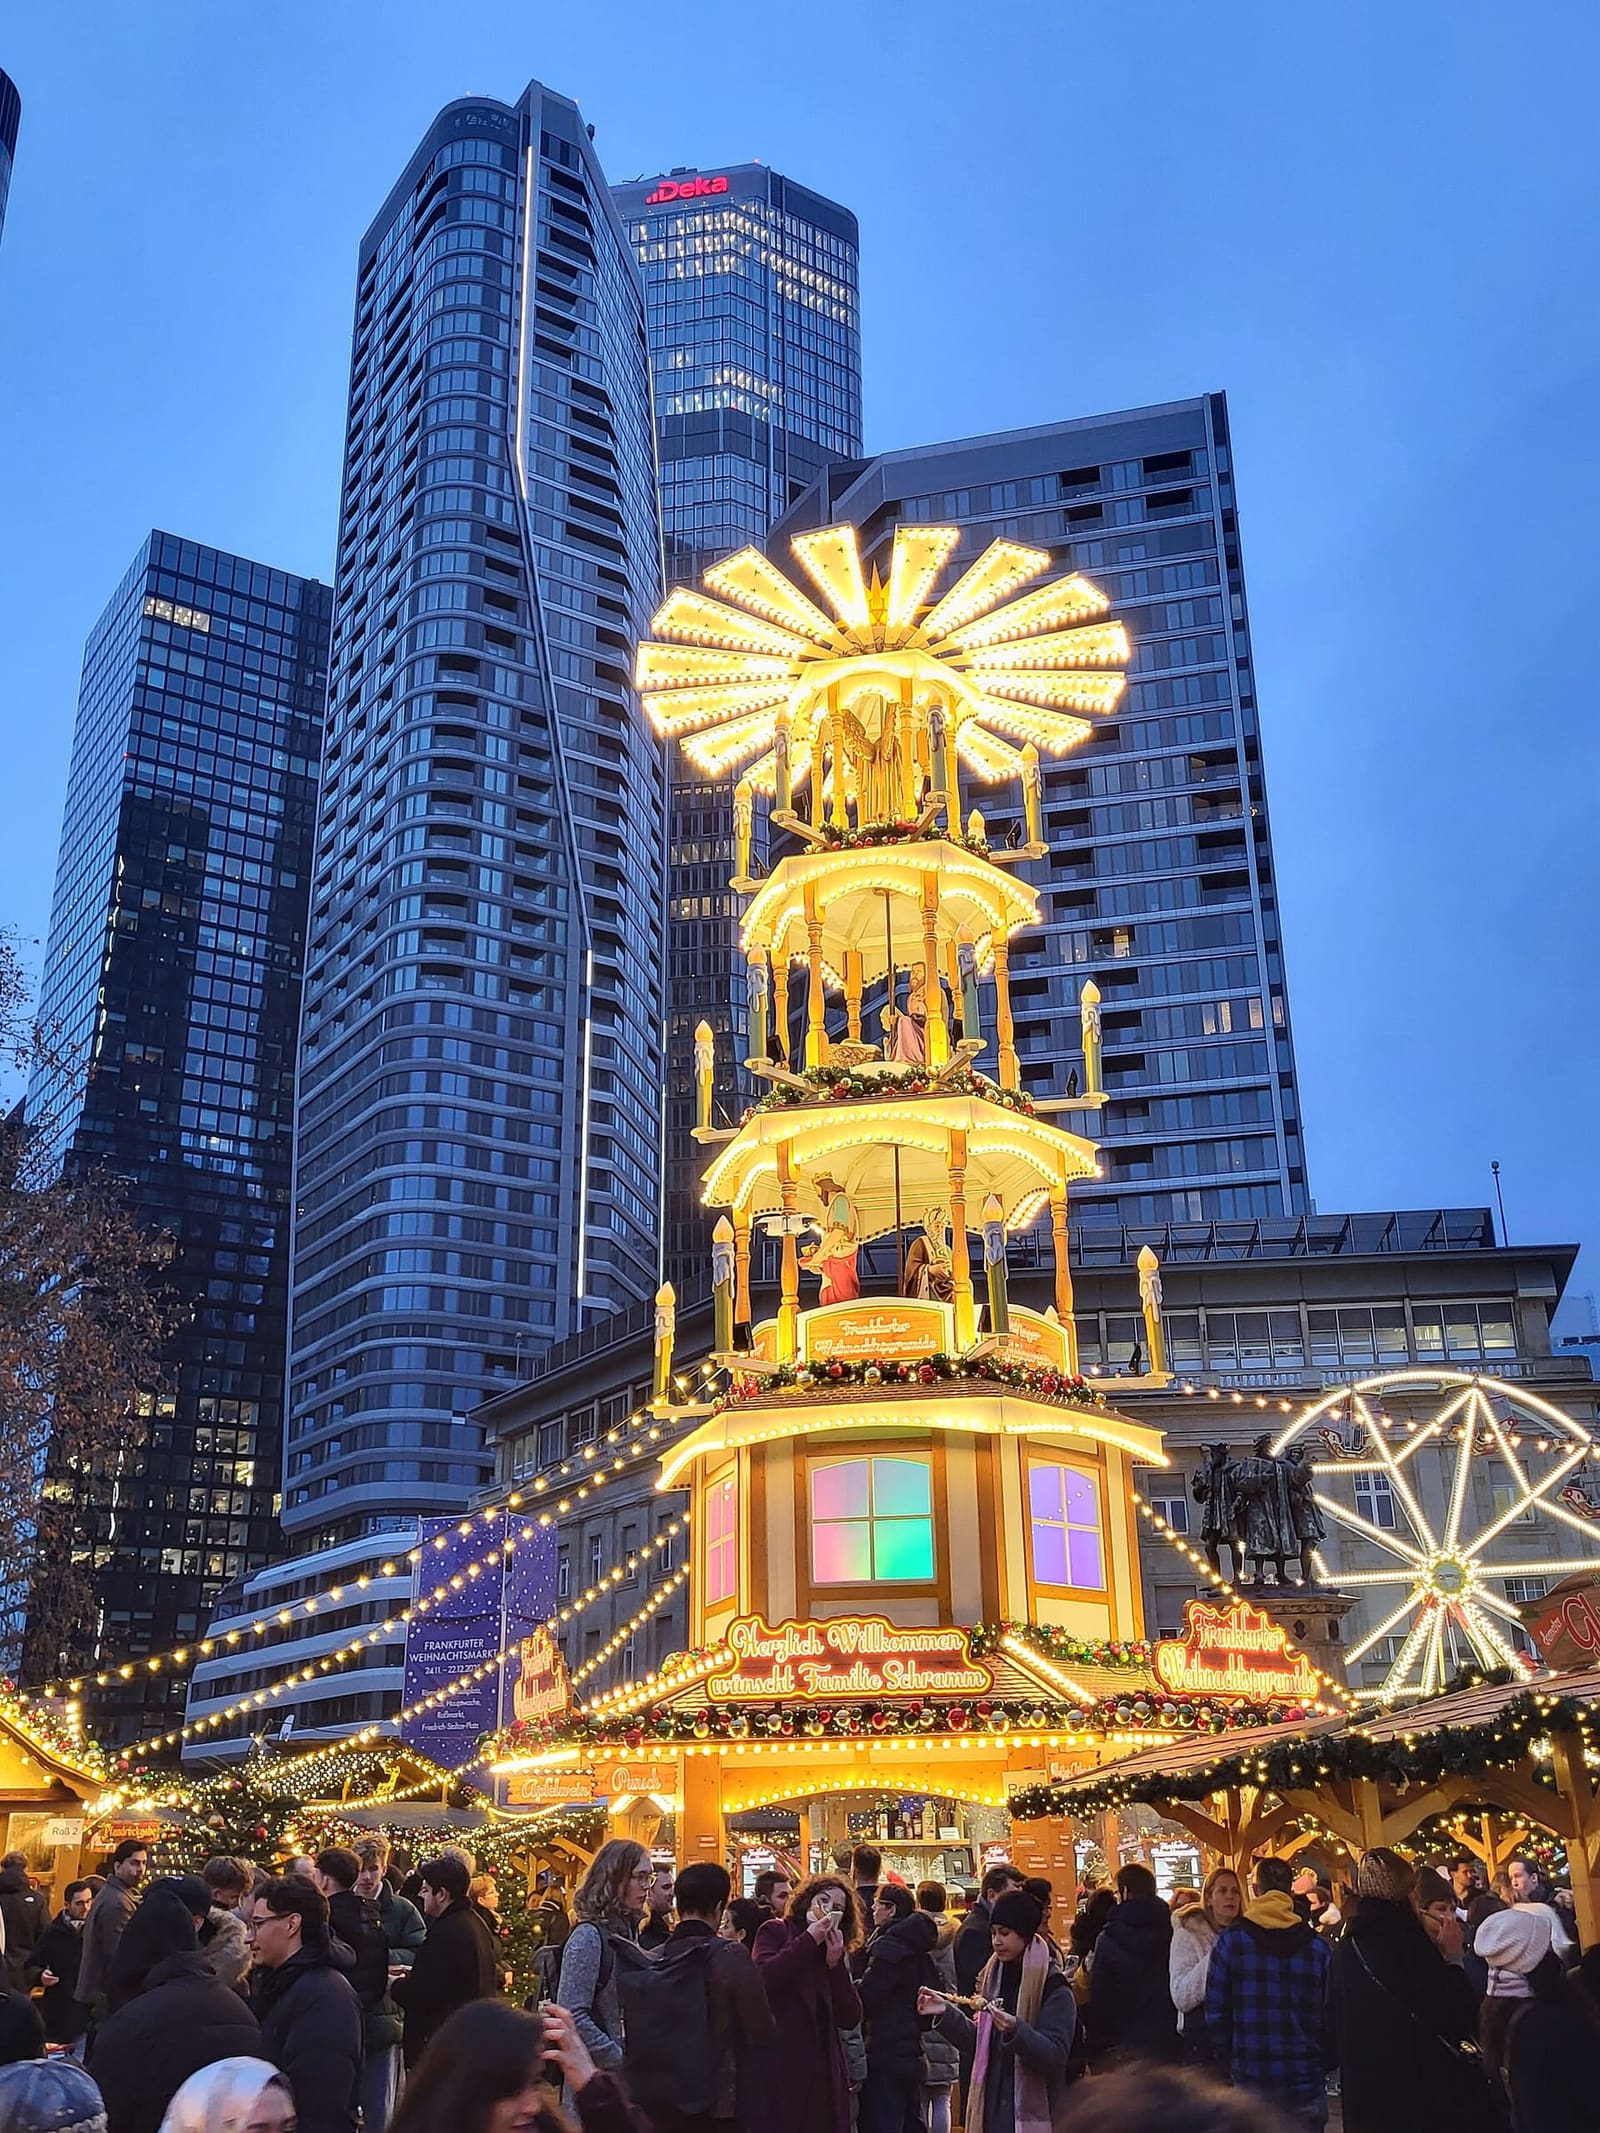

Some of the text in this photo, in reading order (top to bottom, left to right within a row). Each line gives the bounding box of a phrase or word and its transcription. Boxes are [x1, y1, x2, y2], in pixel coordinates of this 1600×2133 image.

[658, 176, 728, 201] Deka
[1192, 1605, 1283, 1652] Frankfurter
[424, 1638, 484, 1651] FRANKFURTER
[734, 1622, 963, 1663] Herzlich Willkommen
[409, 1648, 499, 1663] WEIHNACHTSMARKT
[711, 1660, 986, 1694] wünscht Familie Schramm
[1159, 1646, 1317, 1700] Weihnachtspyramide
[521, 1777, 591, 1802] Apfelwein
[611, 1766, 662, 1792] Punsch
[52, 1826, 79, 1836] Roß 2
